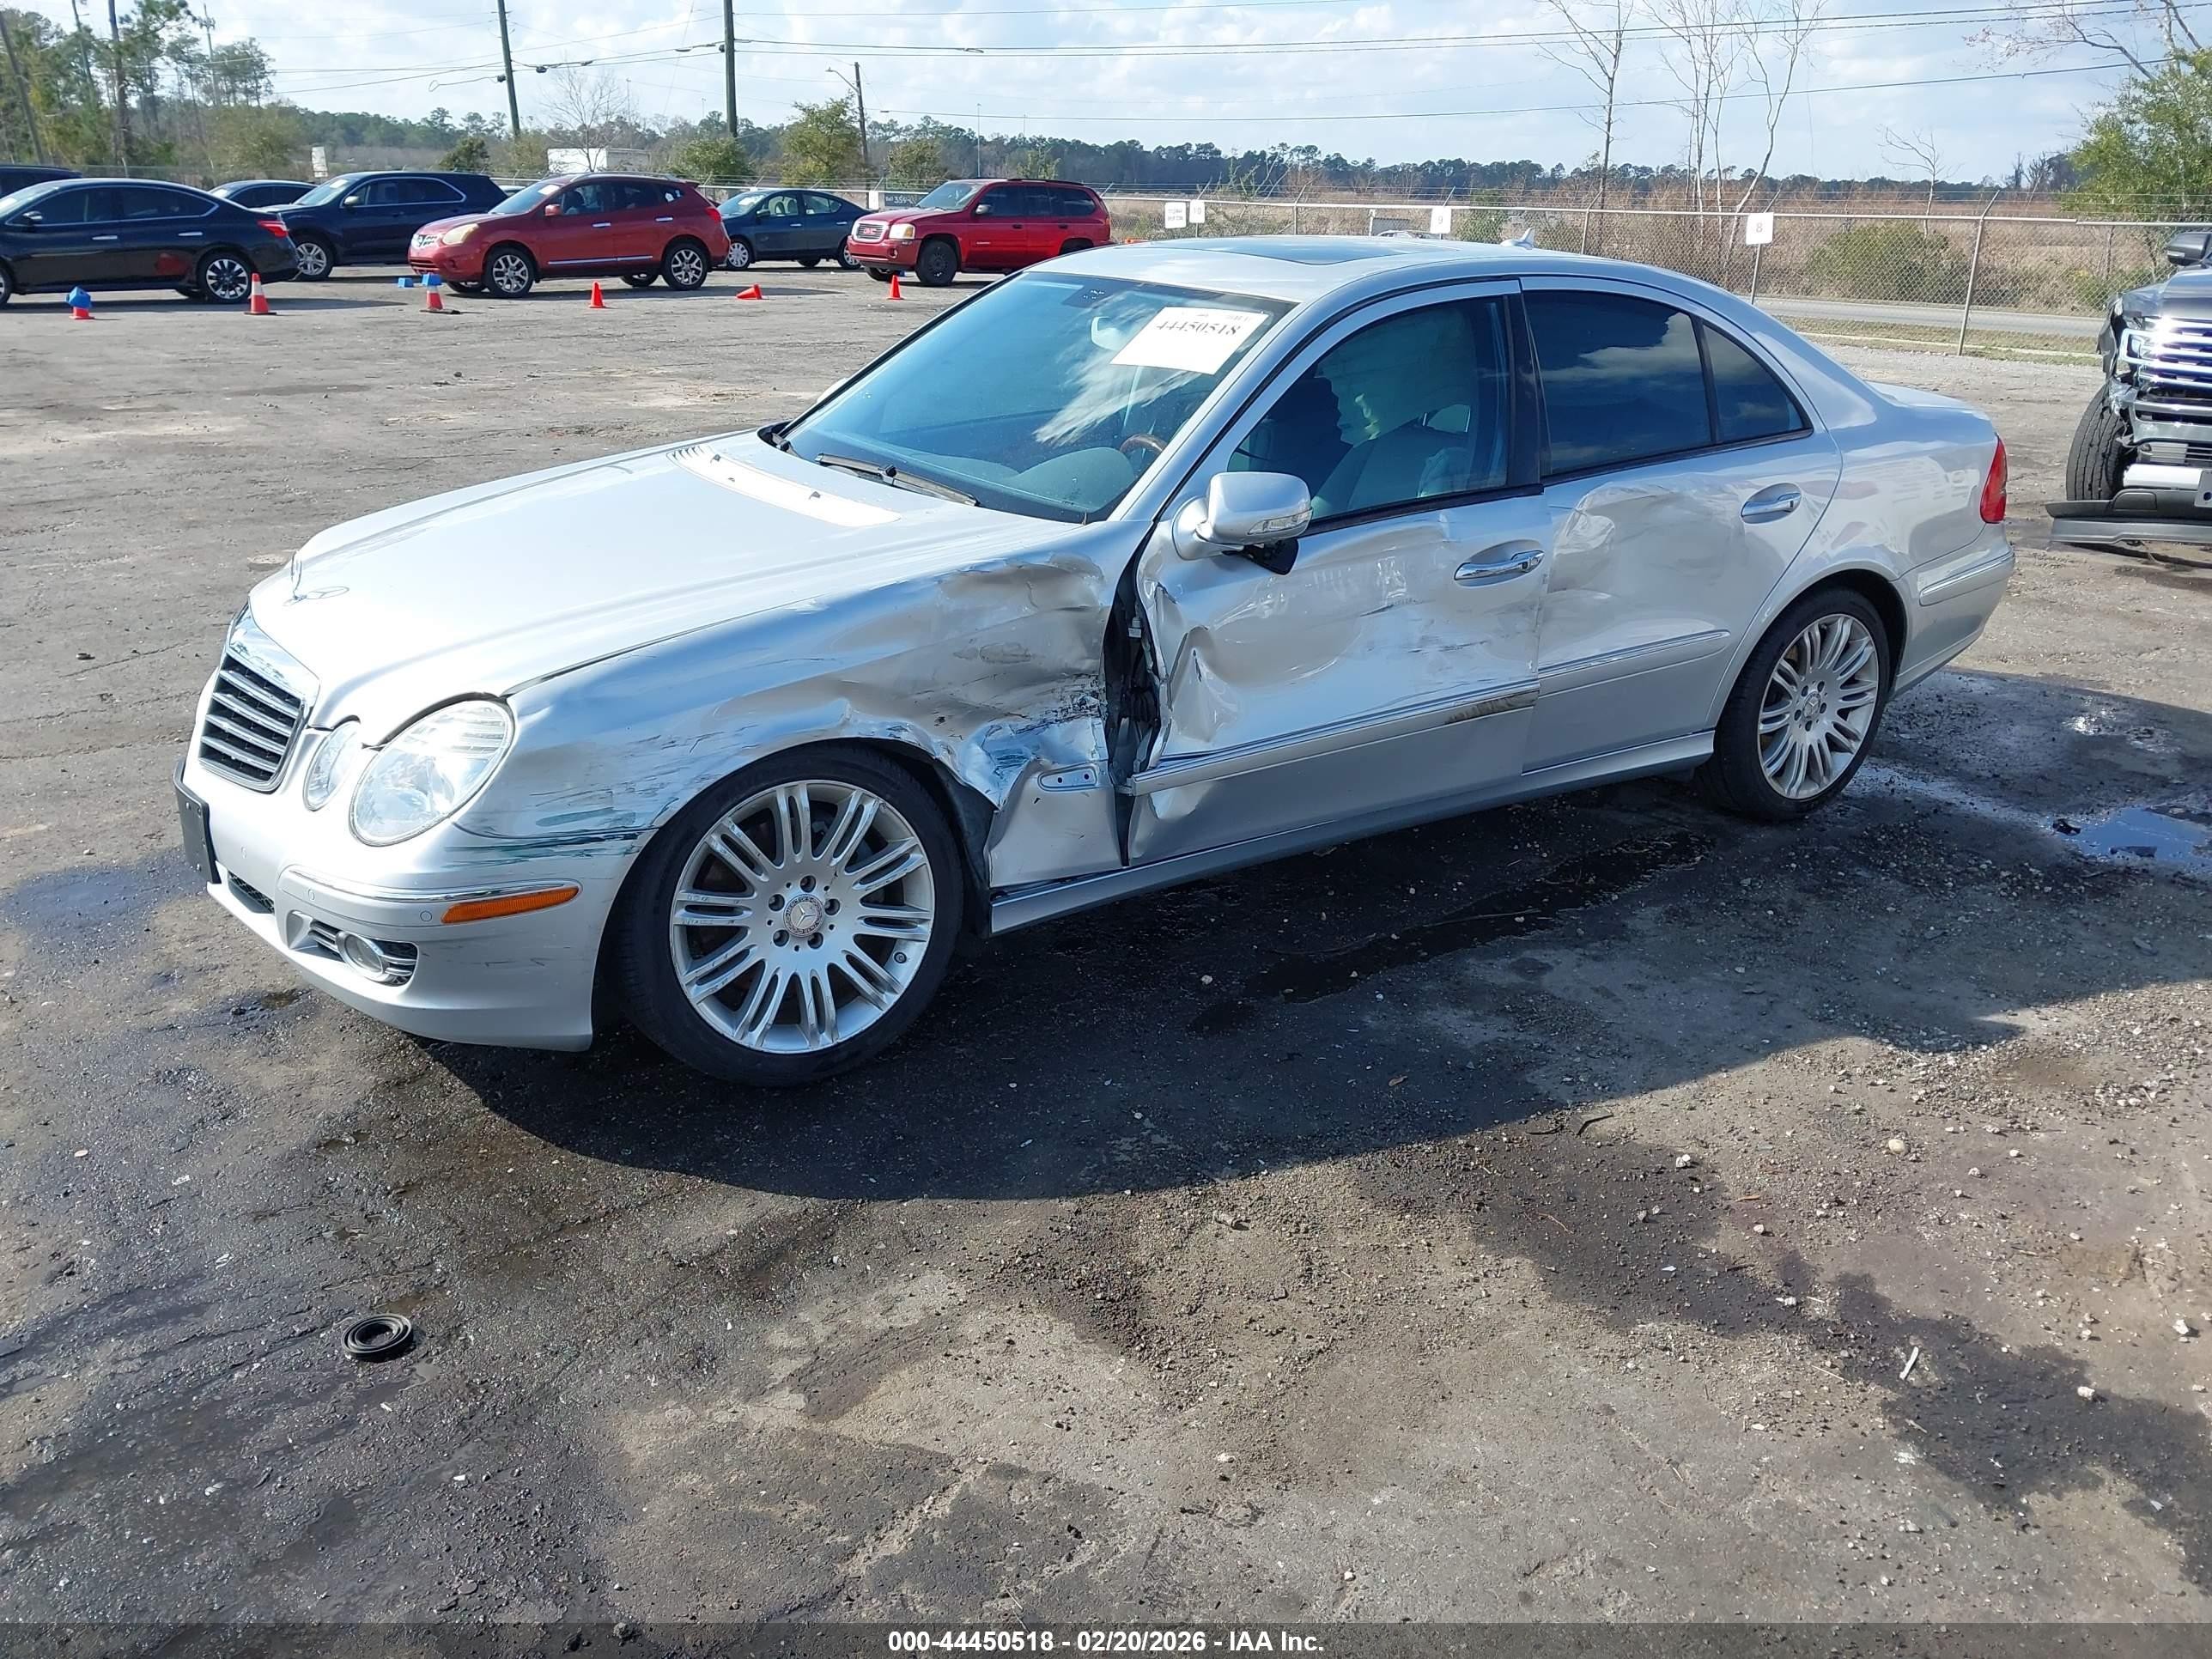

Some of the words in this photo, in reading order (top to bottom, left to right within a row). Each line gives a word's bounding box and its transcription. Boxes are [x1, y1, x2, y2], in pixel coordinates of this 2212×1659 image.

[1193, 206, 1202, 215] 10
[1437, 216, 1443, 224] 9
[1755, 222, 1763, 233] 8
[1156, 321, 1242, 336] 44450518
